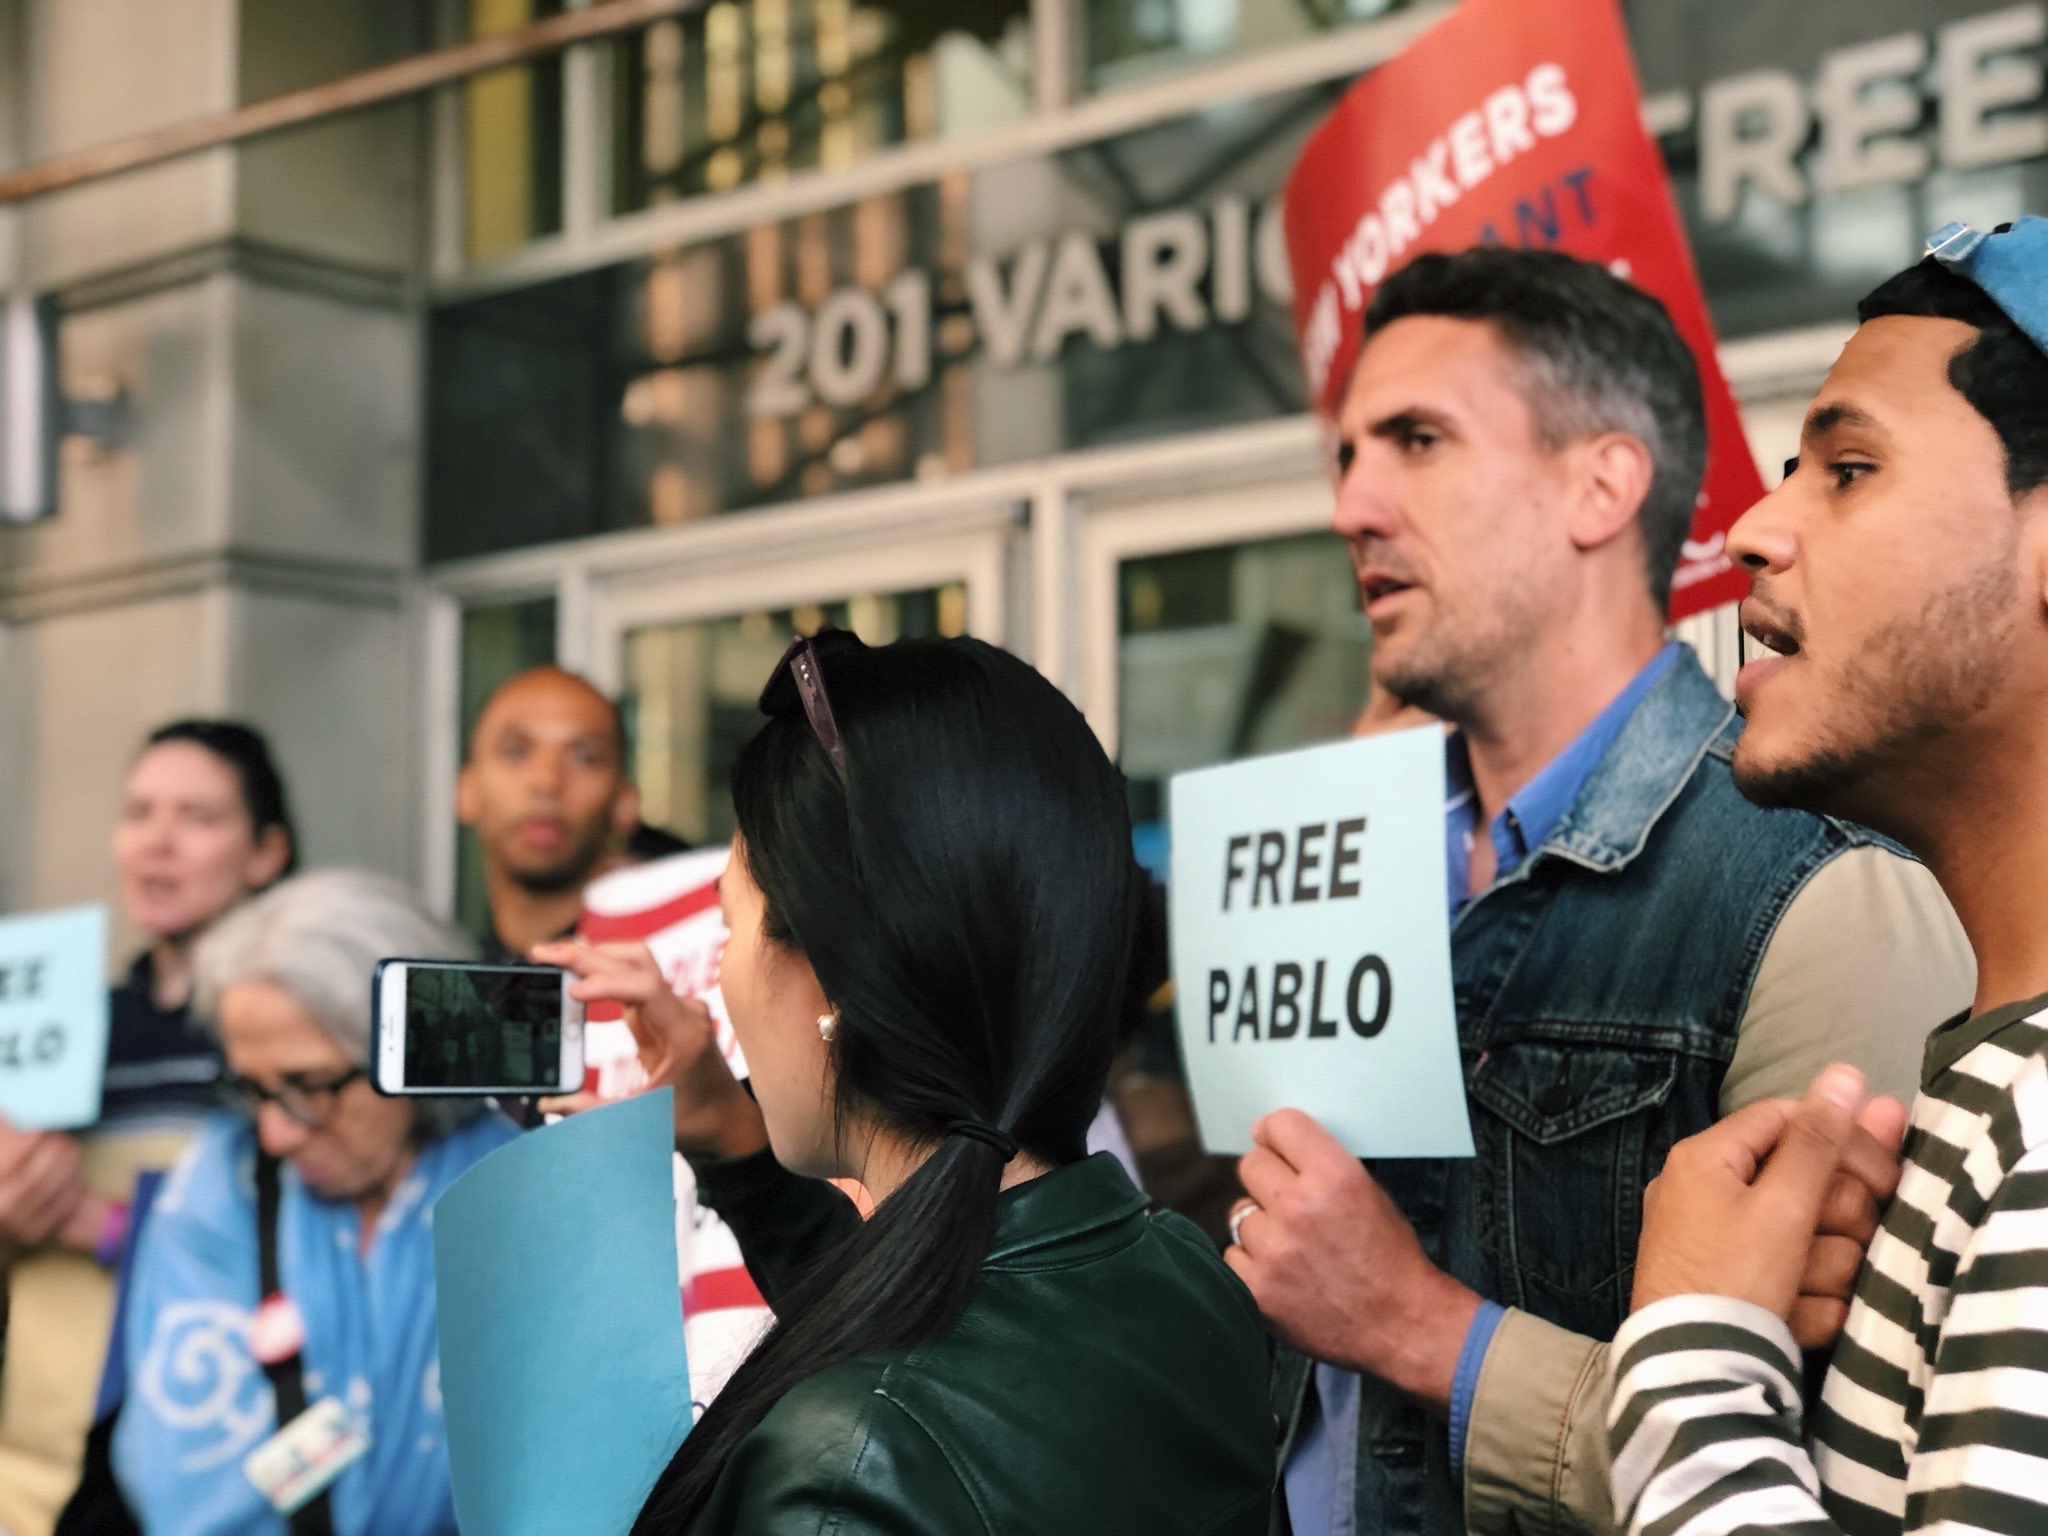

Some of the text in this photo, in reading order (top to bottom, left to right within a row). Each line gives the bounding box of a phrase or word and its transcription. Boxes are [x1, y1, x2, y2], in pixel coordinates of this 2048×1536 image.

[746, 268, 930, 418] 201
[1640, 3, 2046, 224] REE
[1331, 62, 1577, 311] YORKERS
[1221, 817, 1367, 912] FREE
[1208, 953, 1393, 1044] PABLO
